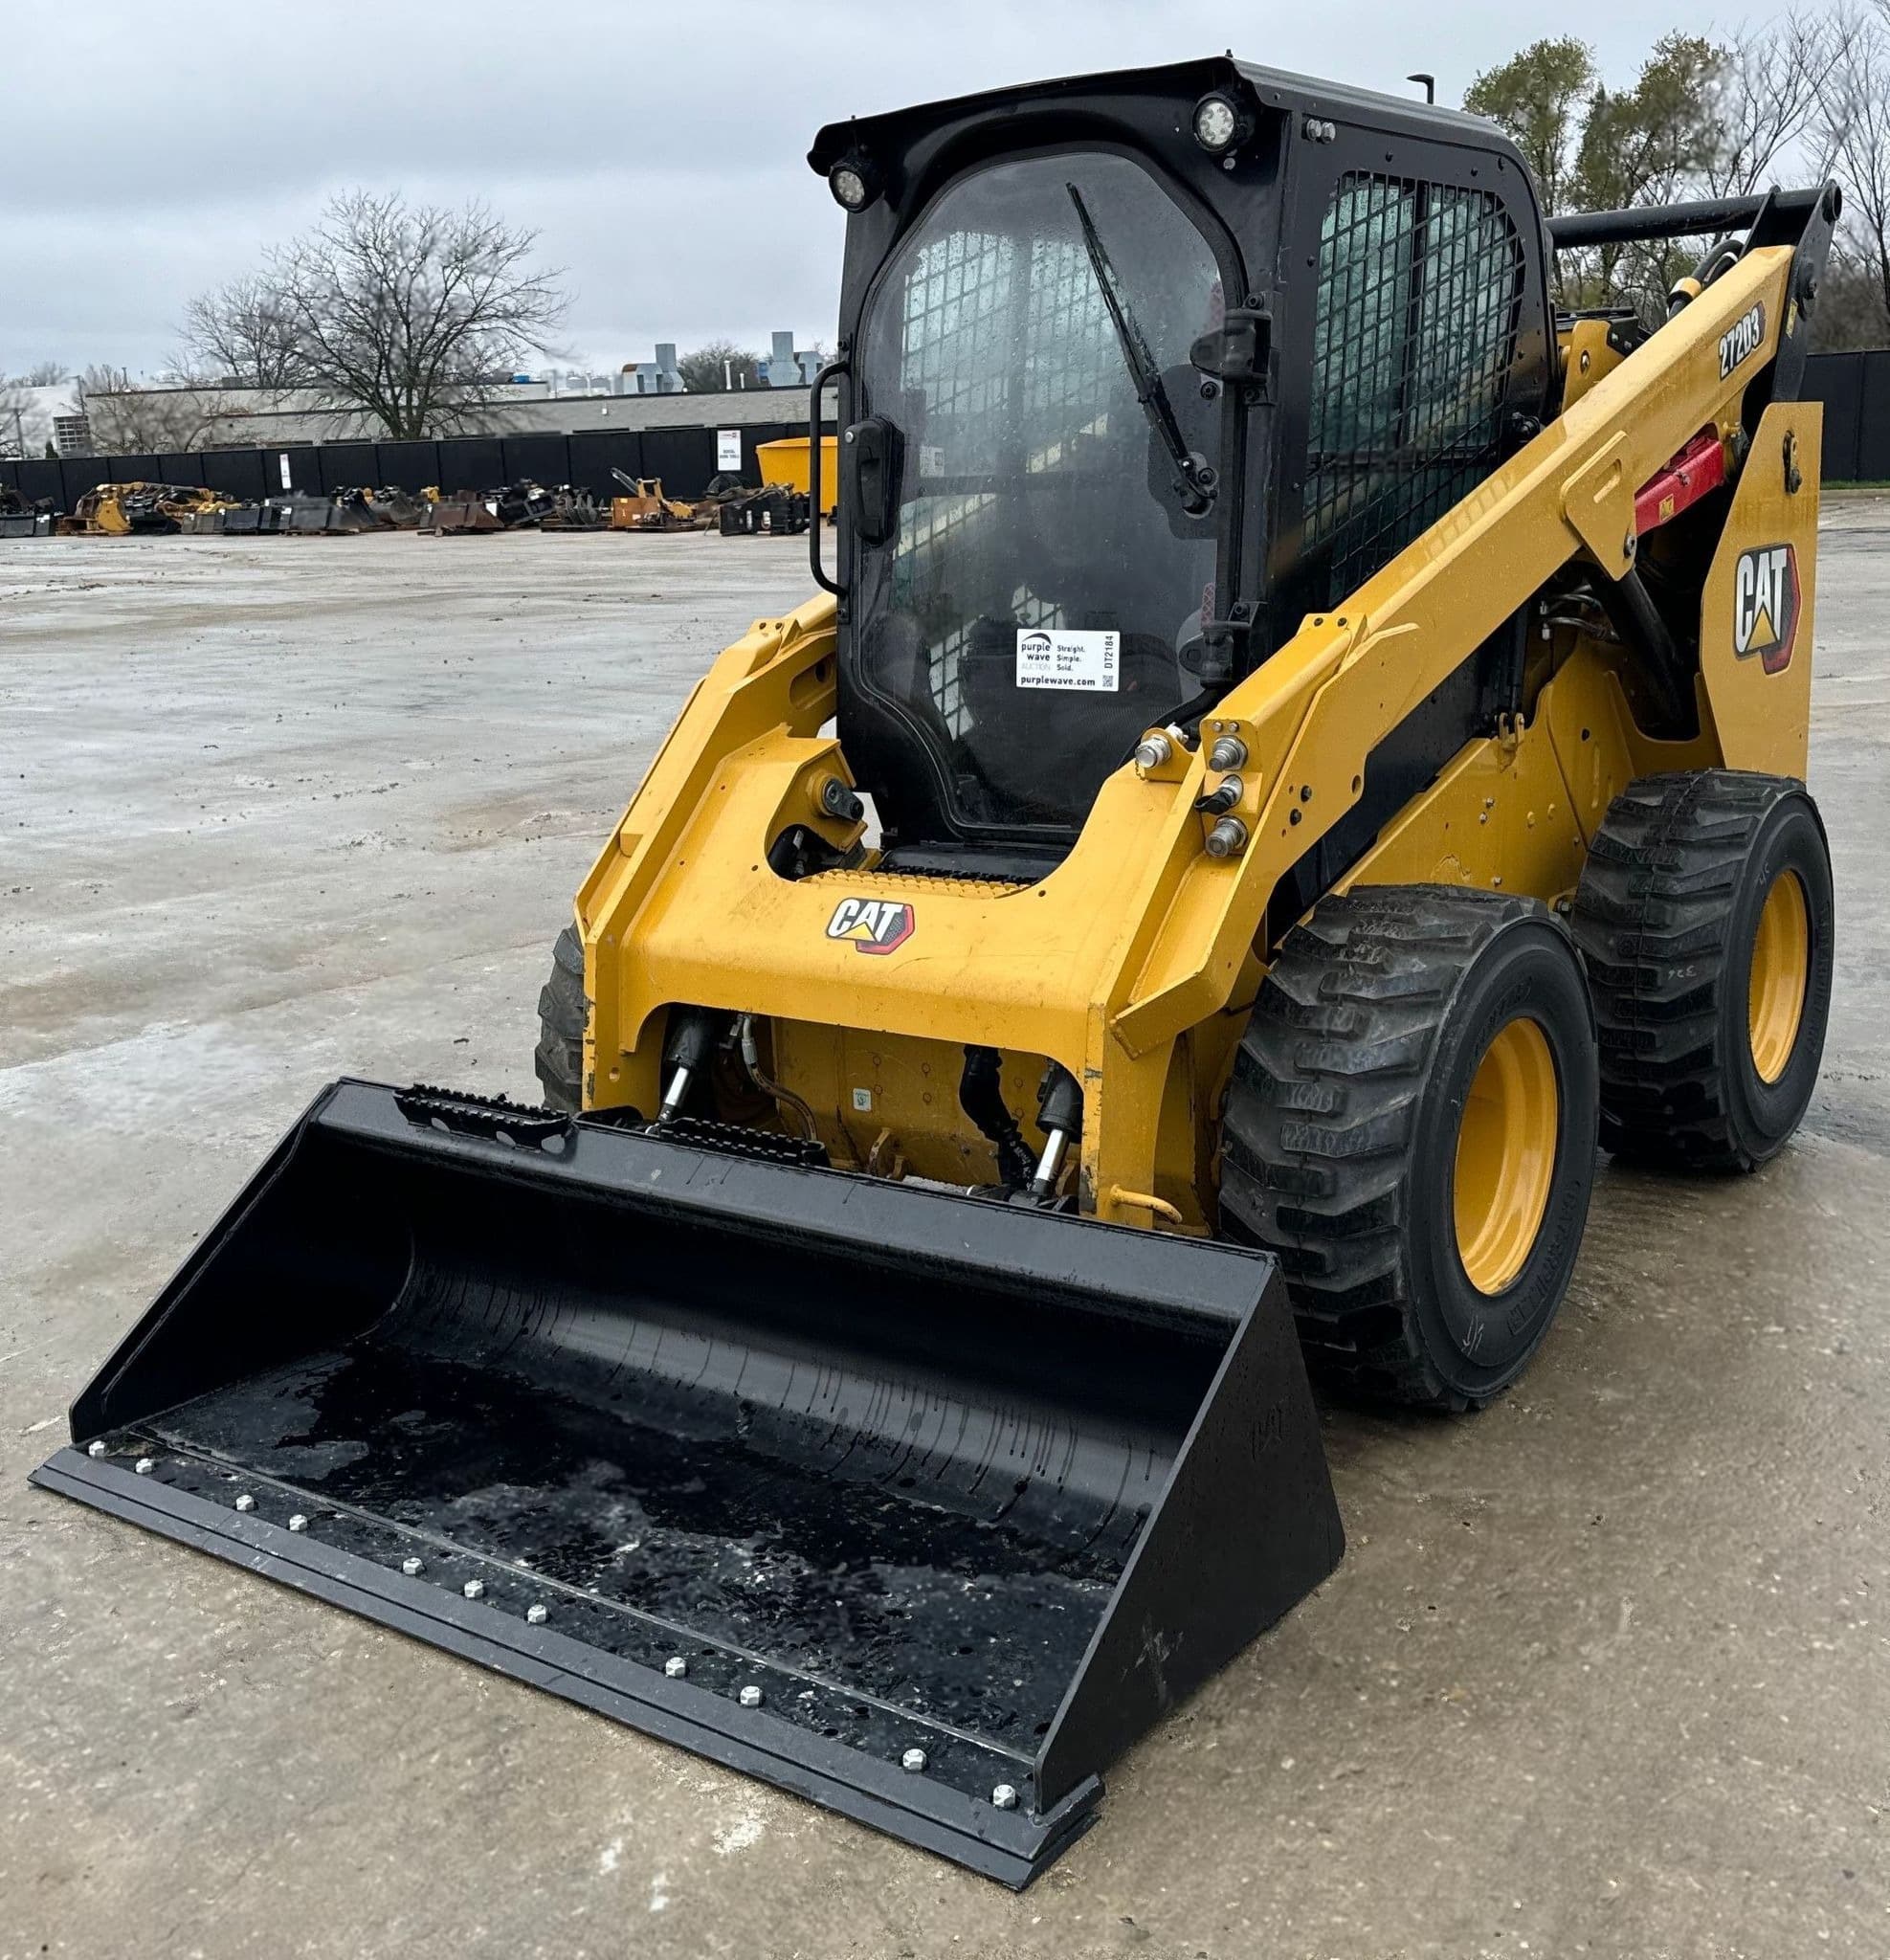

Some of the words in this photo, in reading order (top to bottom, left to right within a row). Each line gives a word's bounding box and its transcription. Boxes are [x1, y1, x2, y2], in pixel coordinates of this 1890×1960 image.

[1719, 306, 1760, 379] 272D3
[1735, 547, 1788, 653] CAT
[1021, 642, 1051, 653] purple
[1056, 645, 1085, 654] Straight.
[1104, 635, 1114, 669] DT2184
[1020, 676, 1096, 686] purplewave.com
[828, 899, 904, 943] CAT
